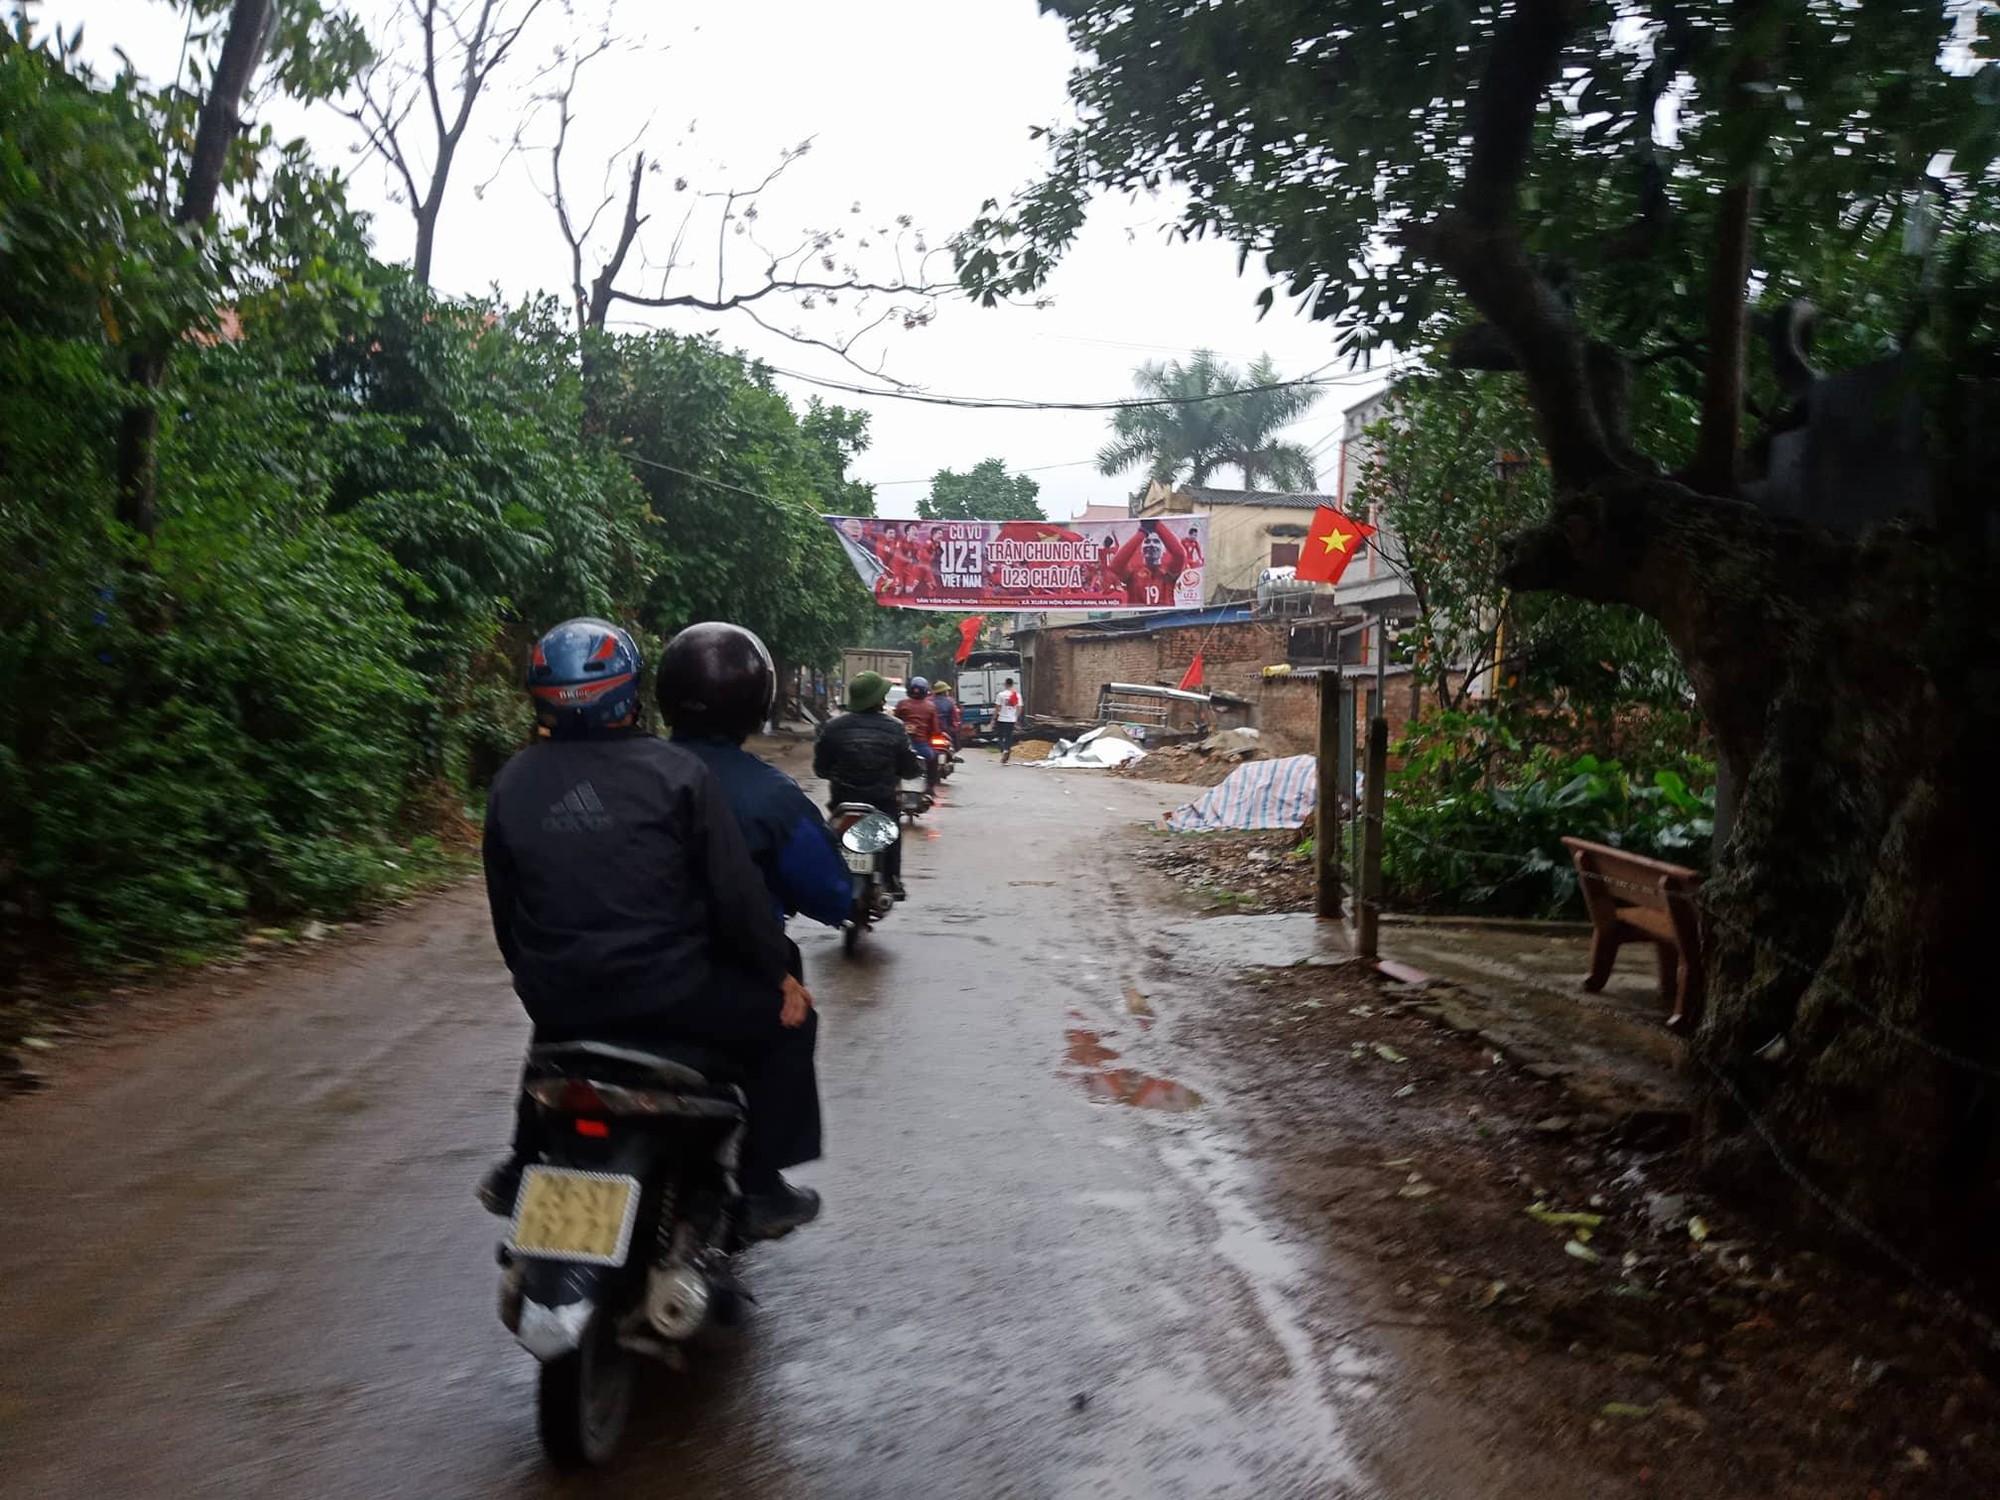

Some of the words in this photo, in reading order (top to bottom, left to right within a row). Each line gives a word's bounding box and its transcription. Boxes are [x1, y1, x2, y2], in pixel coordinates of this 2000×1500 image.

[940, 541, 982, 573] U23
[986, 540, 1022, 564] TRẬN
[1026, 543, 1071, 560] CHUNG
[1074, 539, 1099, 561] KẾT
[962, 574, 982, 588] NAM
[1003, 569, 1029, 586] U23
[1032, 566, 1069, 587] CHÂU
[1070, 565, 1081, 586] Á
[1145, 585, 1160, 606] 19
